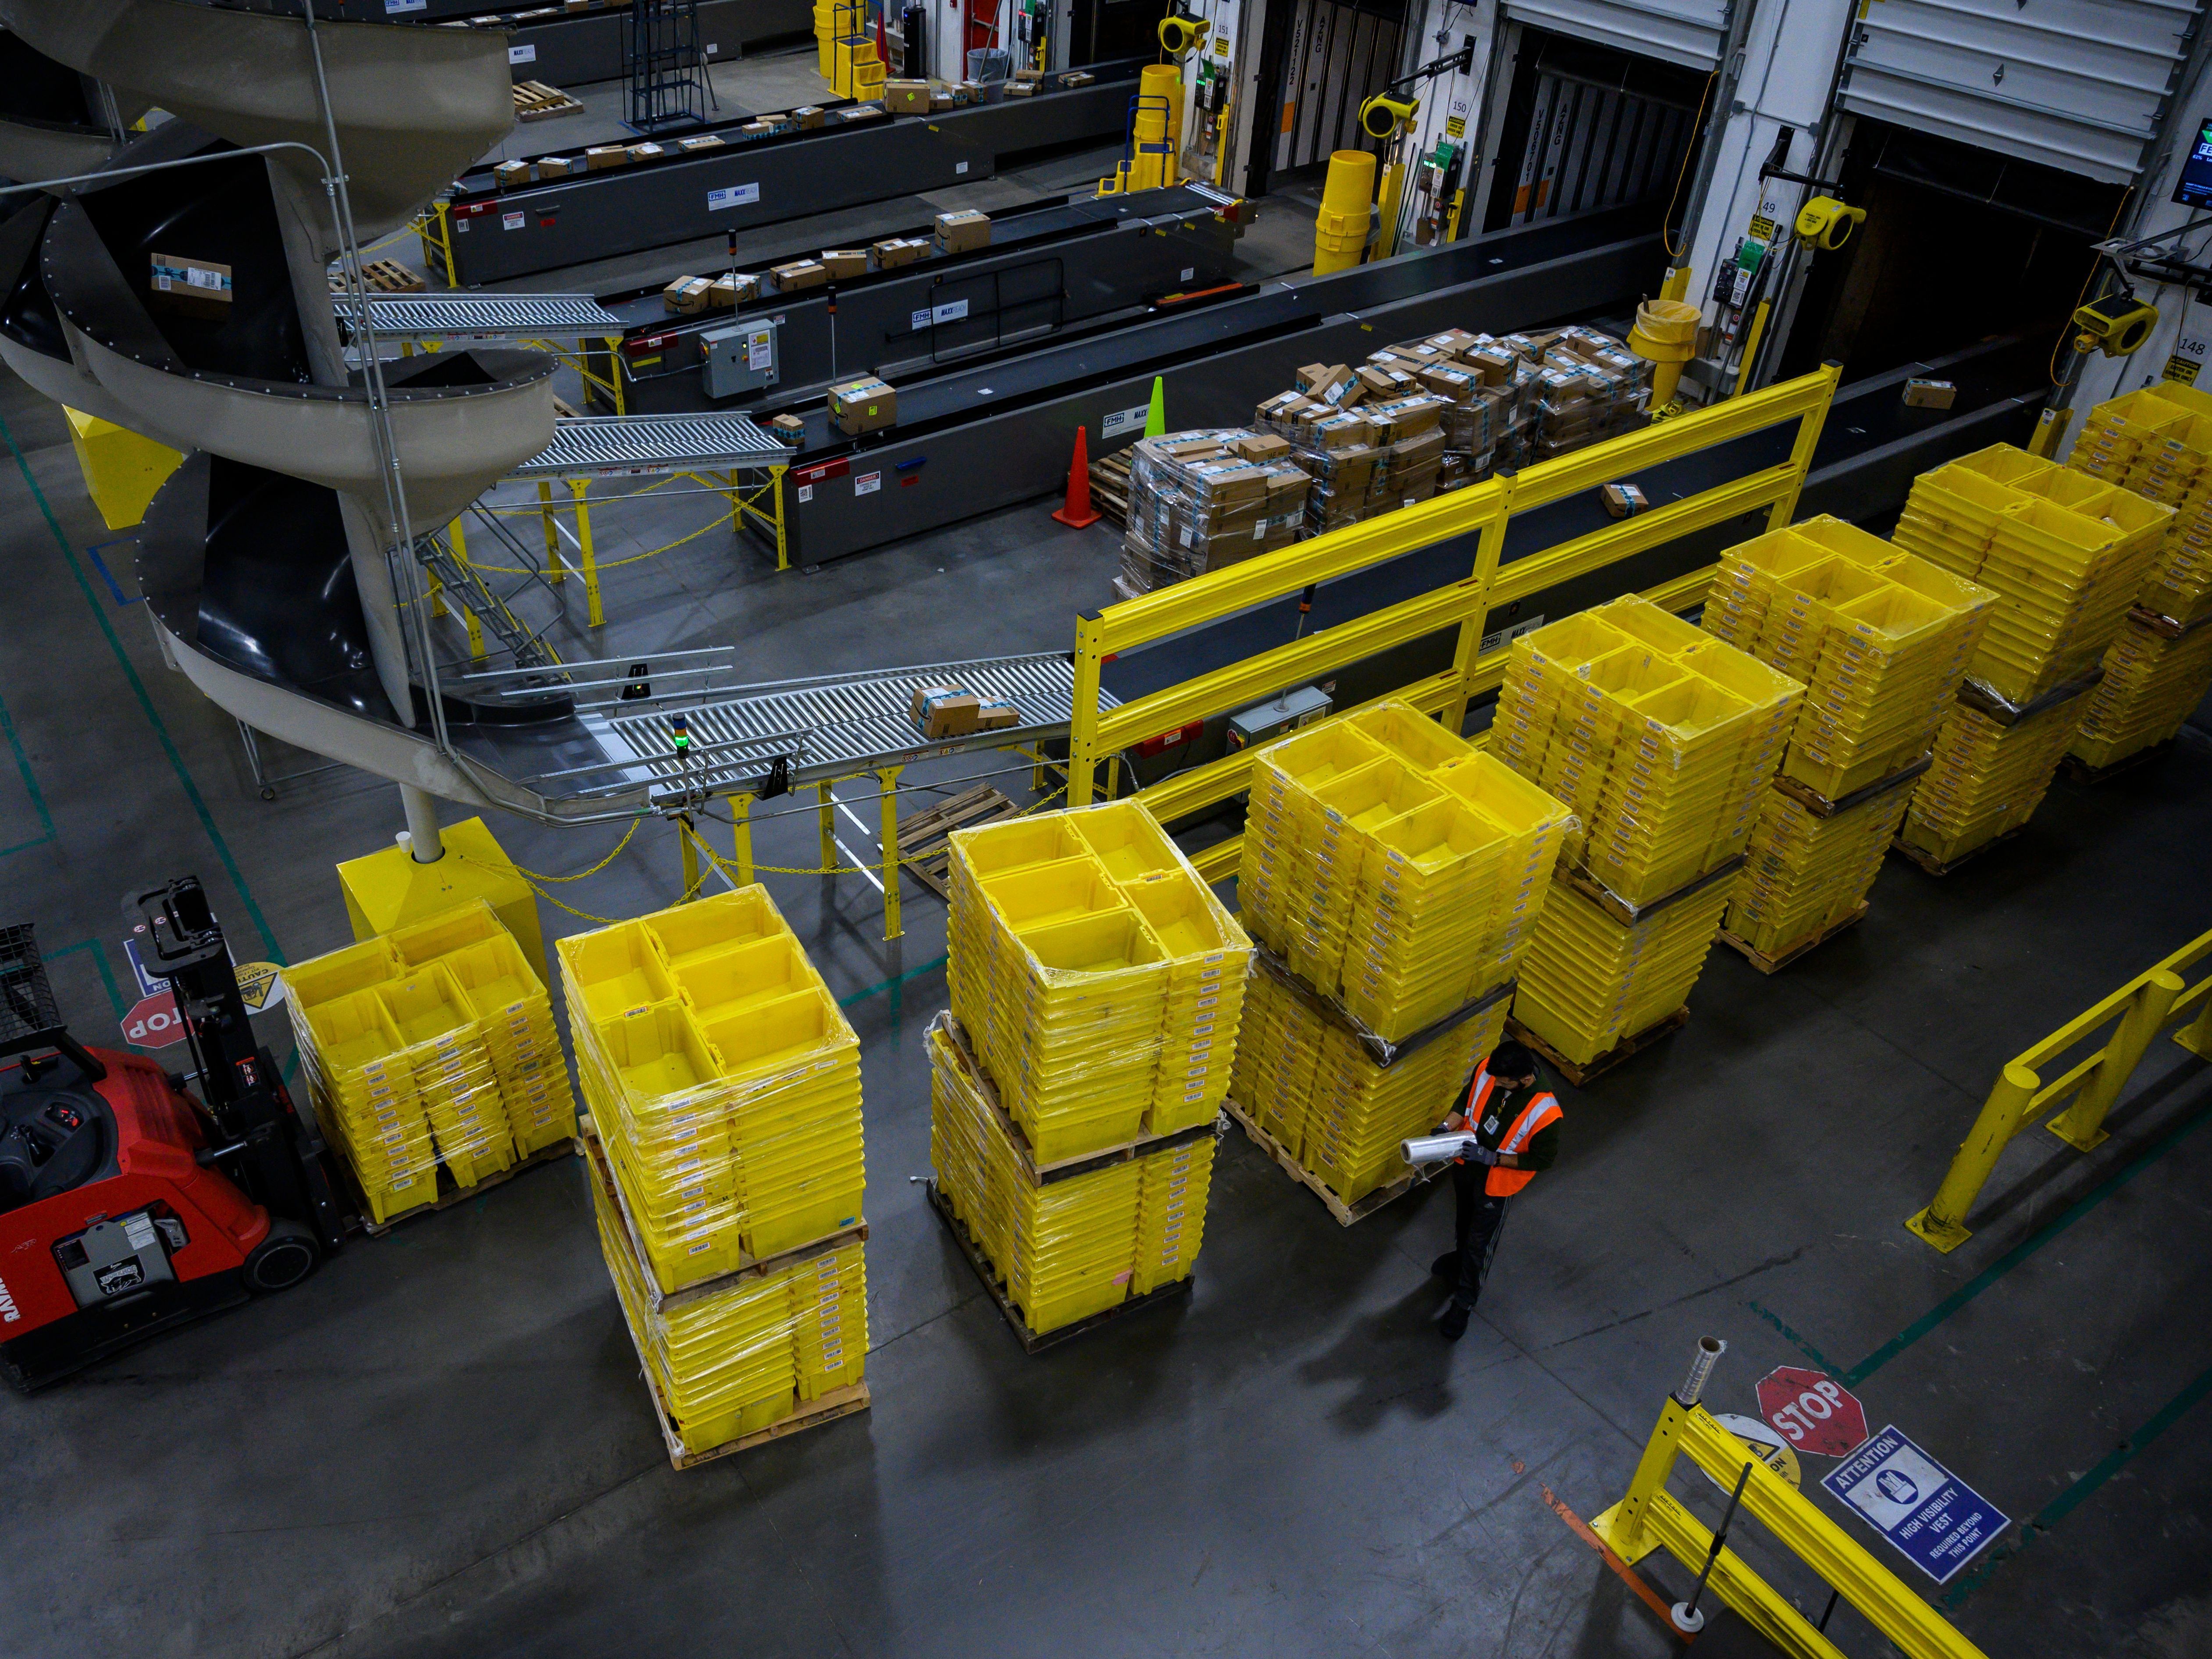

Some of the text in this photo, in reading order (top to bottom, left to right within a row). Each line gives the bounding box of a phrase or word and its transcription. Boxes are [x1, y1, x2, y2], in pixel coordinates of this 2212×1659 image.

[1218, 25, 1228, 34] 151
[1316, 16, 1325, 53] AZNG
[1289, 19, 1303, 85] V521122
[1453, 101, 1466, 113] 150
[1554, 104, 1567, 145] AZNG
[1526, 109, 1544, 182] V506701
[1763, 202, 1775, 213] 49
[2180, 338, 2205, 355] 148
[1107, 416, 1122, 424] FMH
[1482, 636, 1498, 648] FMH
[239, 968, 269, 983] CAUTI
[129, 1008, 182, 1039] TOP
[1772, 1381, 1843, 1440] STOP
[1835, 1436, 1899, 1489] ATTENTION
[1899, 1487, 1958, 1540] HIGH VISIBILITY
[1928, 1513, 1953, 1533] VEST
[1929, 1512, 1982, 1559] REQUIRED BEYOND
[1948, 1527, 1982, 1558] THIS POINT
